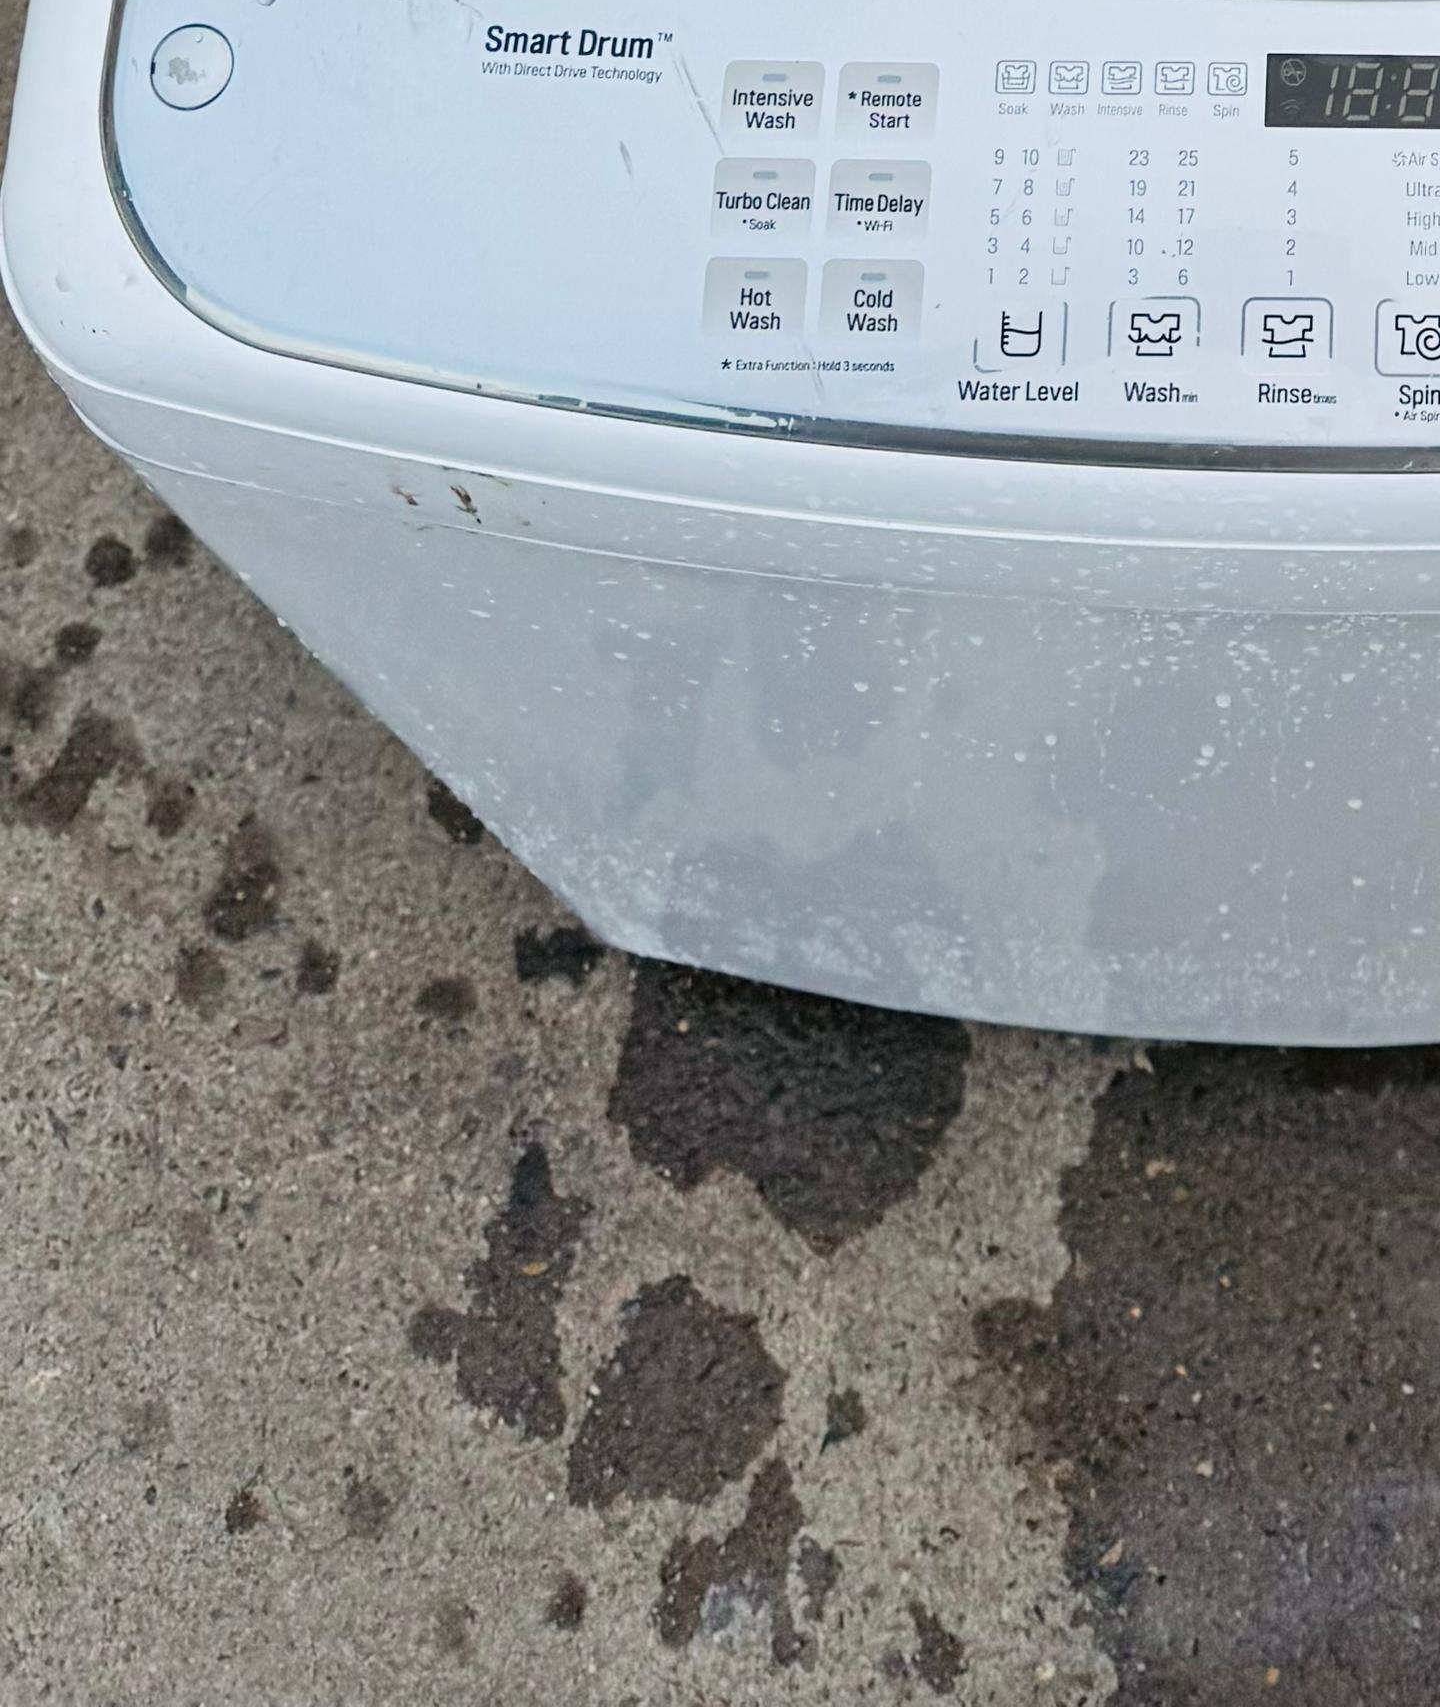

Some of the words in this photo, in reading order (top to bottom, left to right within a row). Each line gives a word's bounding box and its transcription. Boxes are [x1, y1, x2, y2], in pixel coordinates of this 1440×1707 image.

[485, 25, 571, 56] Smart
[481, 61, 511, 76] With
[513, 62, 552, 77] Direct
[553, 64, 587, 79] Drive
[590, 65, 663, 84] Technology
[732, 88, 814, 107] Intensive
[861, 90, 922, 108] Remote
[998, 102, 1029, 116] Soak
[1050, 102, 1085, 116] Wash
[1097, 103, 1143, 116] Intensive
[1158, 103, 1188, 117] Rinse
[1212, 103, 1240, 120] Spin
[745, 110, 796, 130] Wash
[869, 112, 910, 129] Start
[994, 148, 1005, 166] 9
[1021, 148, 1040, 166] 10
[1128, 149, 1150, 167] 23
[1178, 149, 1199, 167] 25
[1288, 148, 1299, 167] 5
[1407, 151, 1428, 166] Air
[993, 178, 1003, 196] 7
[1023, 178, 1034, 196] 8
[1129, 179, 1147, 197] 19
[1177, 179, 1195, 197] 21
[1287, 180, 1298, 197] 4
[715, 191, 763, 210] Turbo
[766, 192, 811, 211] Clean
[834, 192, 875, 212] Time
[877, 194, 924, 217] Delay
[748, 218, 777, 231] Soak
[989, 208, 1000, 226] 5
[1021, 208, 1033, 226] 6
[1128, 207, 1145, 224] 14
[1178, 207, 1195, 225] 17
[1286, 208, 1297, 226] 3
[1407, 210, 1440, 231] High
[987, 236, 998, 255] 3
[1020, 237, 1030, 254] 4
[1127, 238, 1144, 256] 10
[1176, 238, 1194, 256] 12
[1285, 238, 1296, 256] 2
[1409, 239, 1438, 257] Mid
[988, 267, 994, 285] 1
[1018, 267, 1029, 285] 2
[1128, 267, 1139, 286] 3
[1178, 268, 1189, 286] 6
[1287, 269, 1294, 287] 1
[1406, 270, 1440, 286] Low
[740, 287, 772, 307] Hot
[853, 289, 894, 309] Cold
[729, 311, 781, 330] Wash
[846, 312, 898, 332] Wash
[736, 360, 763, 370] Extra
[957, 380, 1021, 402] Water
[1025, 380, 1079, 402] Level
[1124, 381, 1180, 403] Wash
[1258, 383, 1312, 404] Rinse
